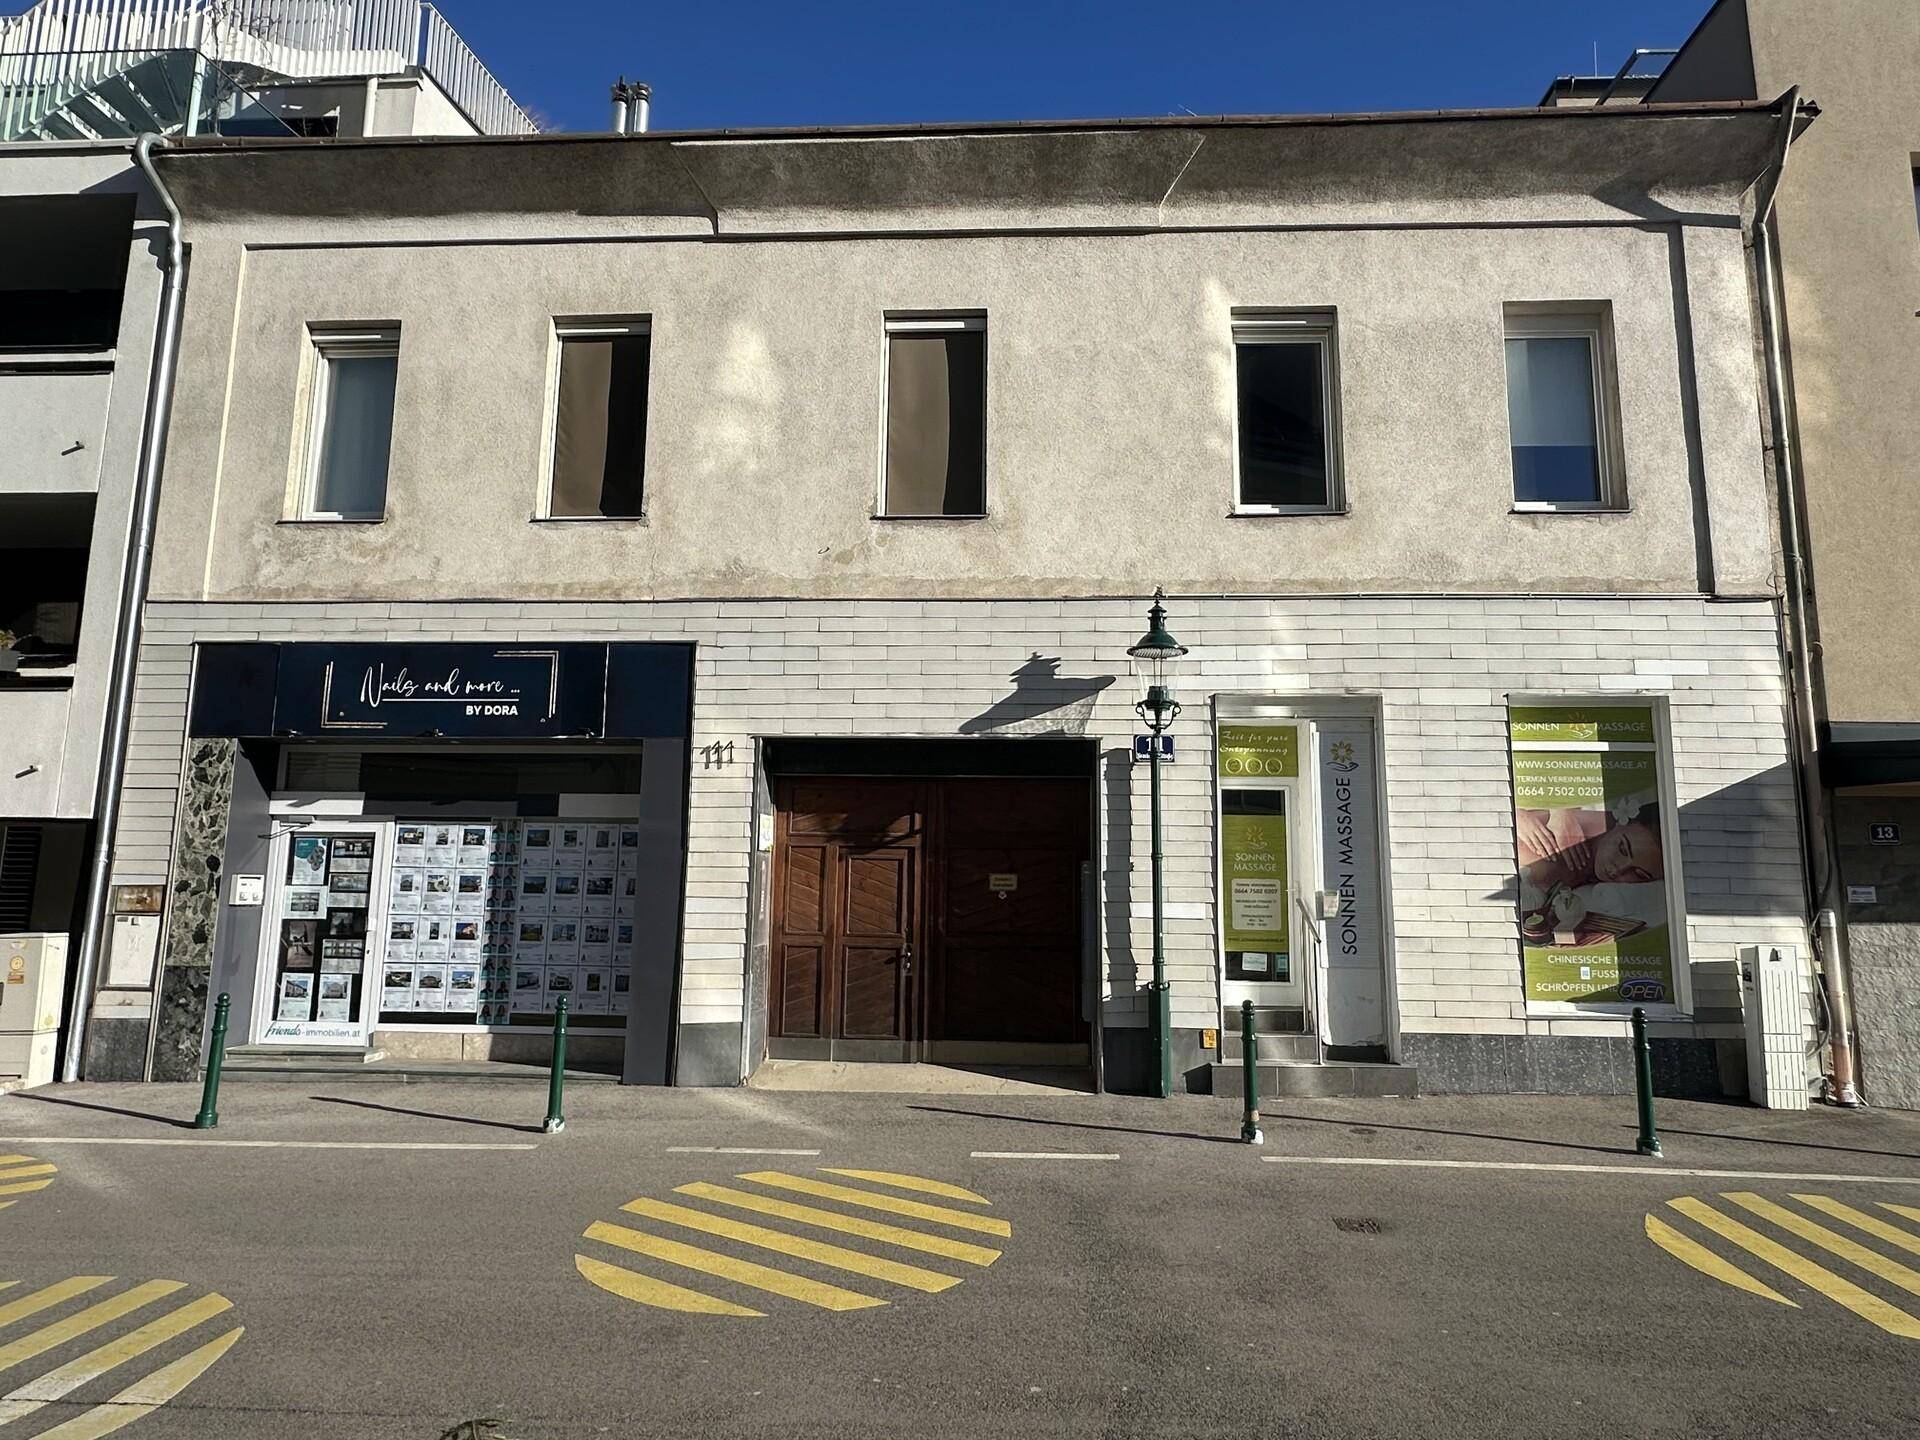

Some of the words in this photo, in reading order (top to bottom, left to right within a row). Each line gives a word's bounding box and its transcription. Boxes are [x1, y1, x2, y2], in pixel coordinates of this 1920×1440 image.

[360, 662, 419, 707] Nails
[424, 667, 460, 695] and
[465, 680, 503, 694] more
[465, 705, 482, 716] BY
[484, 705, 519, 716] DORA
[1512, 721, 1560, 732] SONNEN
[1594, 721, 1648, 732] MASSAGE
[1515, 760, 1648, 769] WWW.SONNENMASSAGE.AT
[1517, 786, 1544, 796] 0664
[1548, 786, 1575, 796] 7502
[1577, 786, 1604, 796] 0207
[1335, 777, 1354, 865] MASSAGE
[1877, 826, 1894, 839] 13
[1235, 852, 1275, 861] SONNEN
[1233, 863, 1277, 872] MASSAGE
[1341, 873, 1358, 955] SONNEN
[1547, 954, 1612, 964] CHINESISCHE
[1614, 956, 1663, 965] MASSAGE
[1591, 970, 1664, 979] FUSSMASSAGE
[1536, 982, 1595, 992] SCHRÖPFEN
